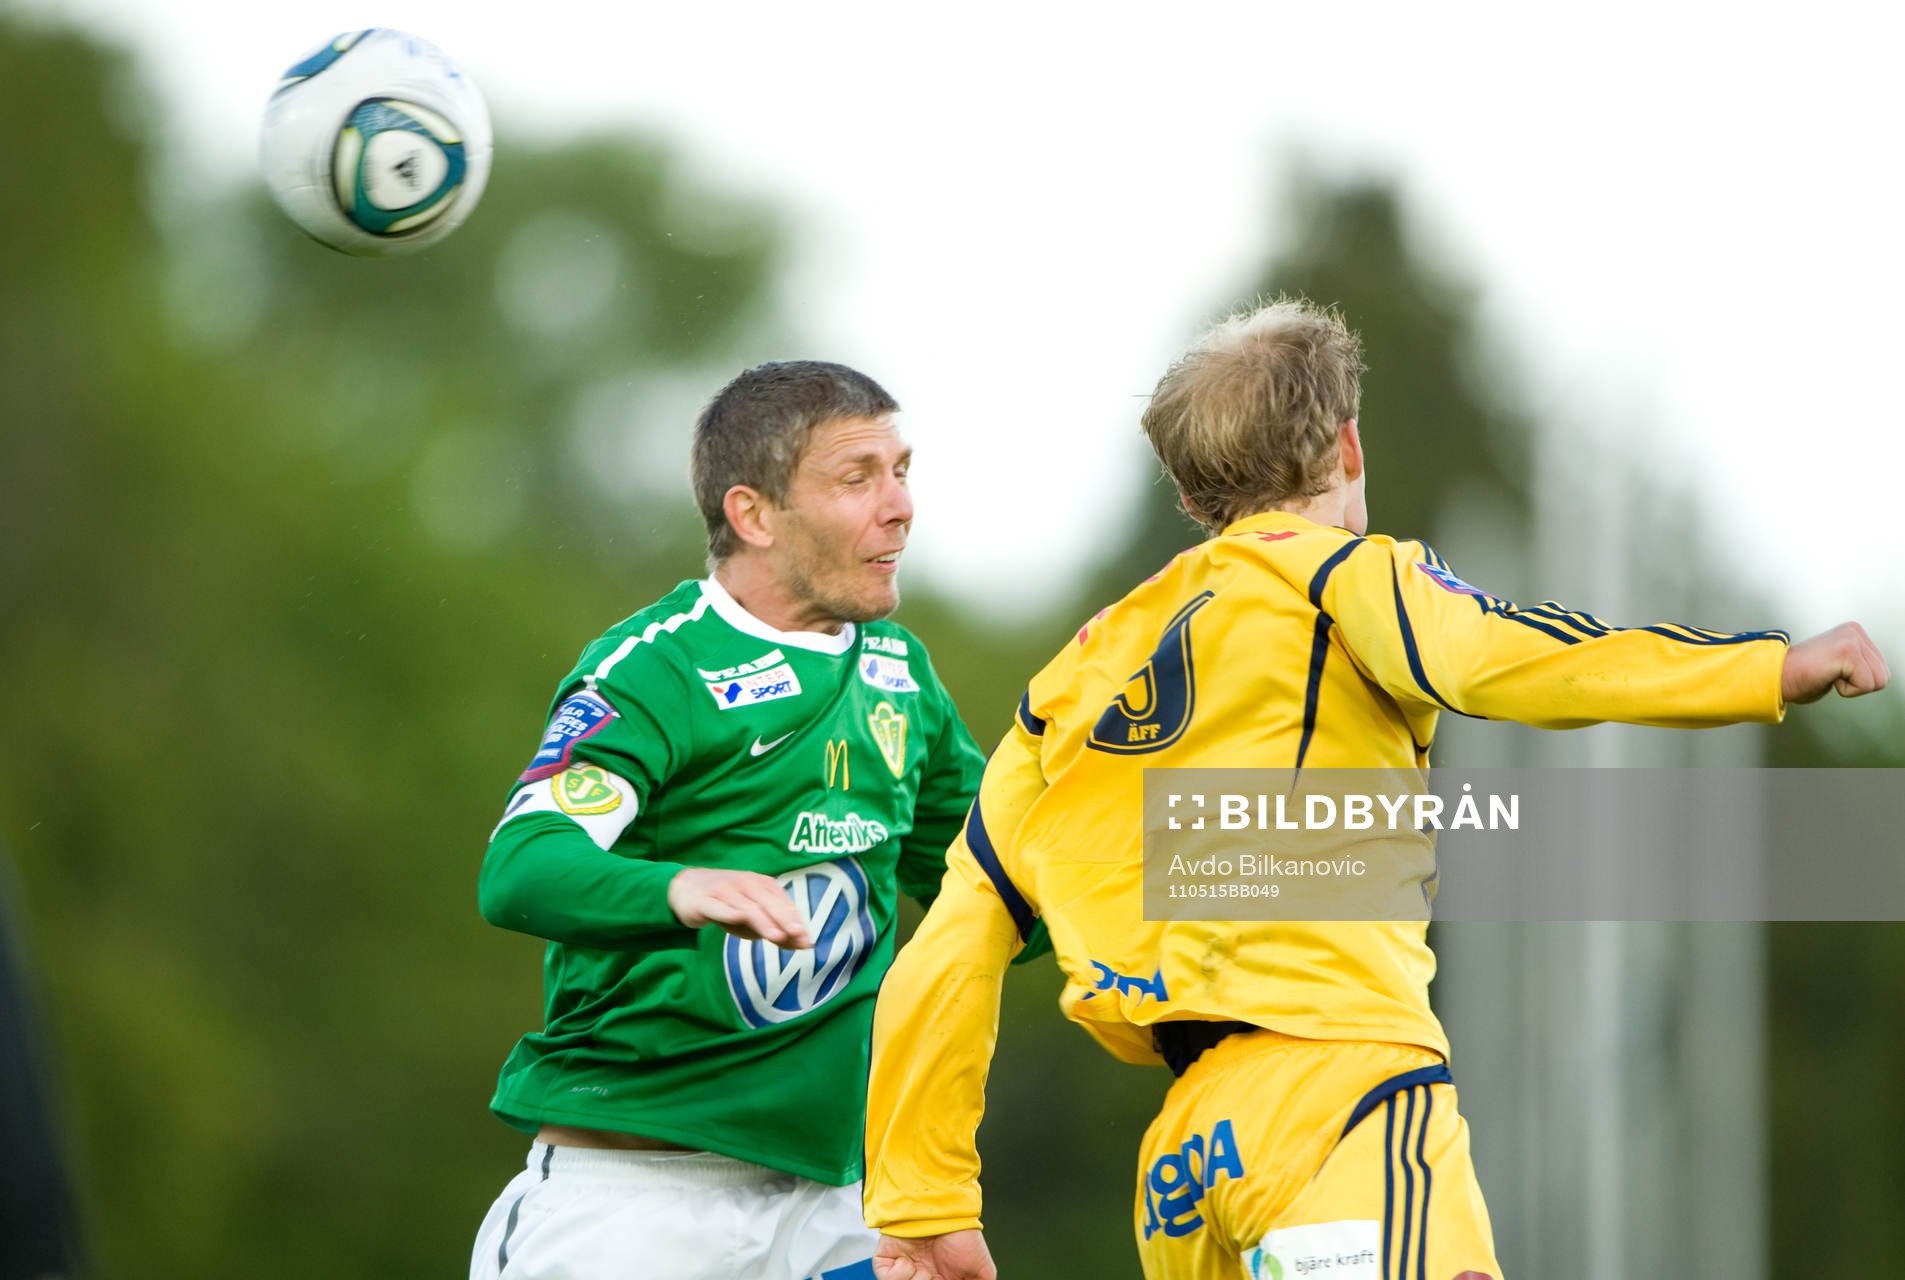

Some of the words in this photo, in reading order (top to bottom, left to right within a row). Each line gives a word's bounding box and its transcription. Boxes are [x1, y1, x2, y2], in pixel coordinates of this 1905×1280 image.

[750, 681, 793, 699] SPORT
[1127, 722, 1161, 742] ÄFF
[1335, 1250, 1374, 1266] kraft
